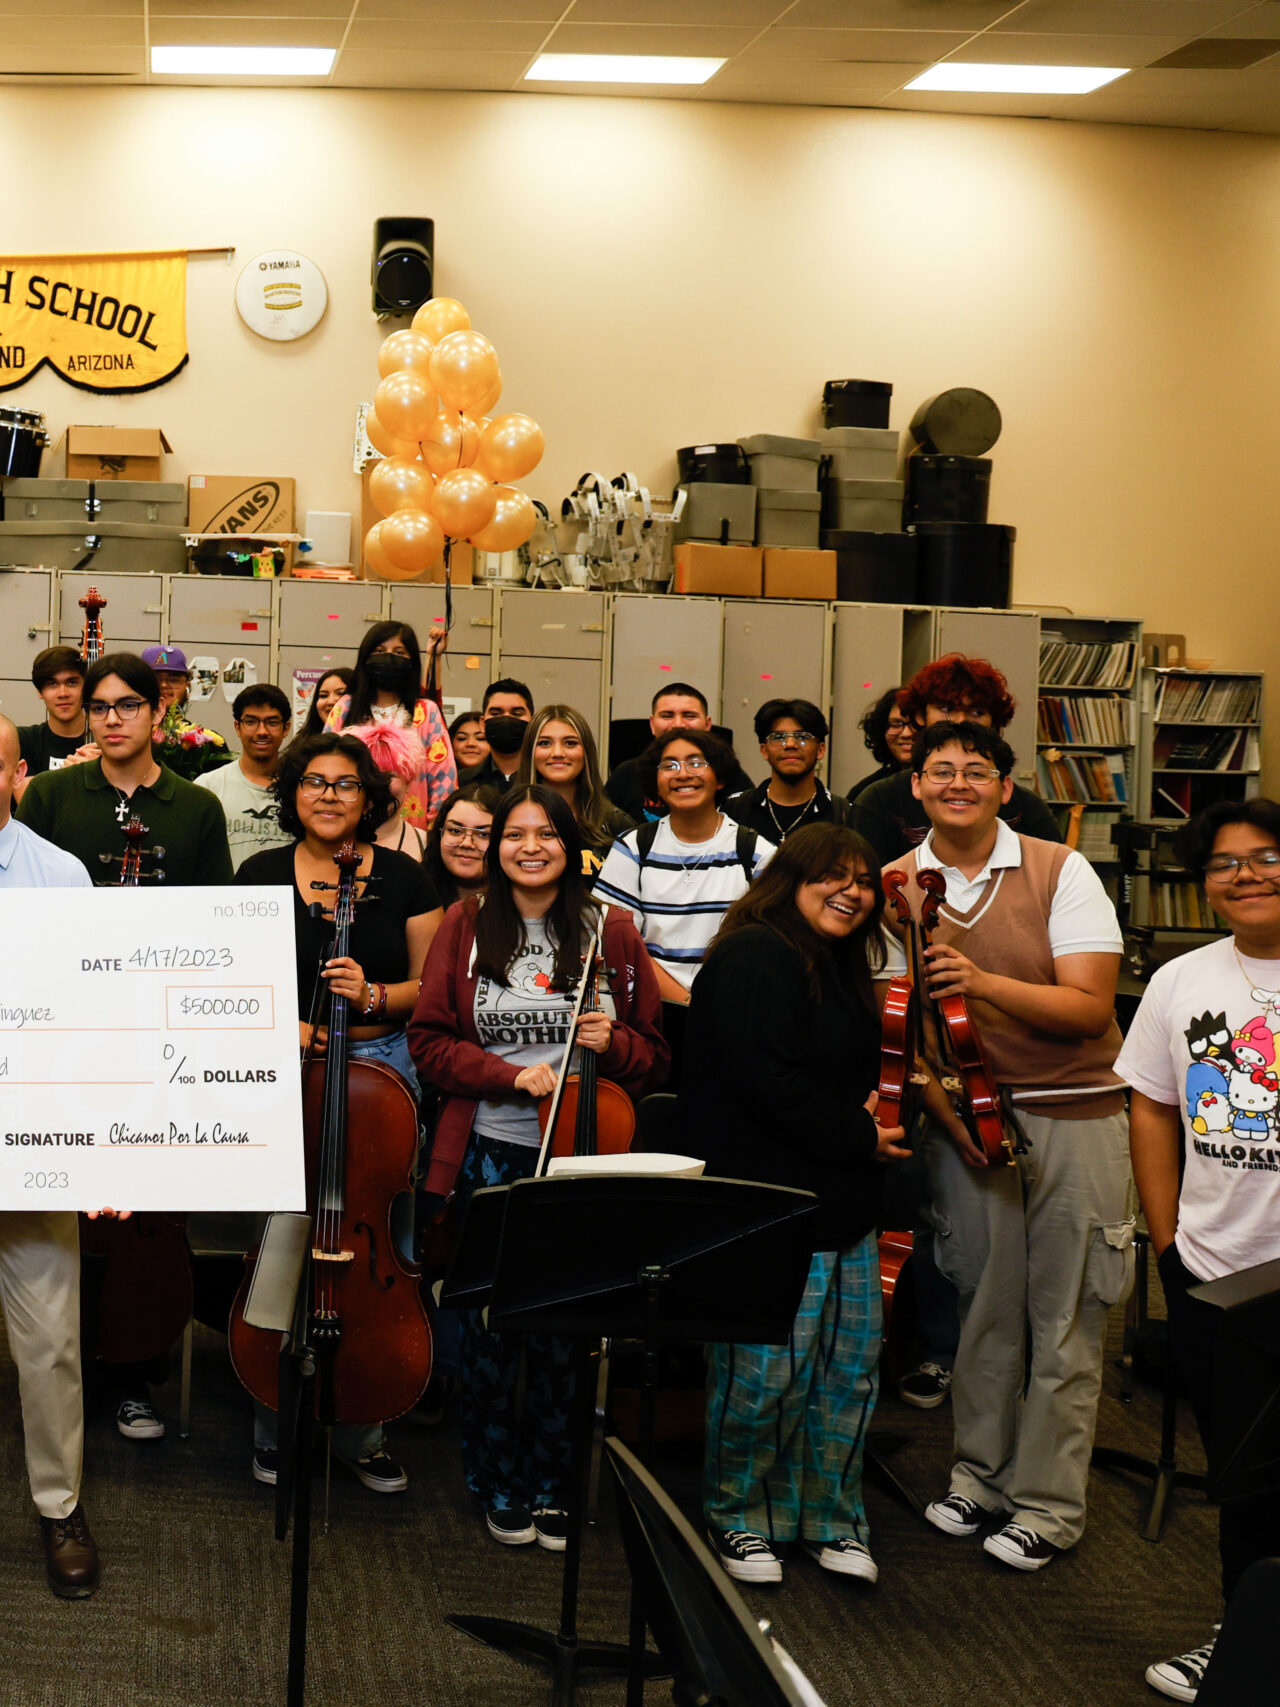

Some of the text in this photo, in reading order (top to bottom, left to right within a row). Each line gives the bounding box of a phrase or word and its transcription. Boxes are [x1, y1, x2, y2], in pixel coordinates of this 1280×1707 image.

[269, 260, 301, 270] YAMAHA
[25, 275, 158, 352] SCHOOL
[67, 354, 135, 372] ARIZONA
[214, 491, 269, 534] VANS
[225, 818, 293, 838] HOLLIST
[81, 946, 234, 972] DATE 4/17/2023
[180, 995, 260, 1015] $5000.00
[477, 1011, 572, 1026] ABSOLUT
[479, 1027, 571, 1044] NOTHI
[203, 1070, 277, 1083] DOLLARS
[5, 1121, 250, 1146] SIGNATURE Chicanos Por La Causa
[1194, 1139, 1246, 1160] HELLO
[1222, 1160, 1238, 1168] AND
[24, 1171, 69, 1189] 2023
